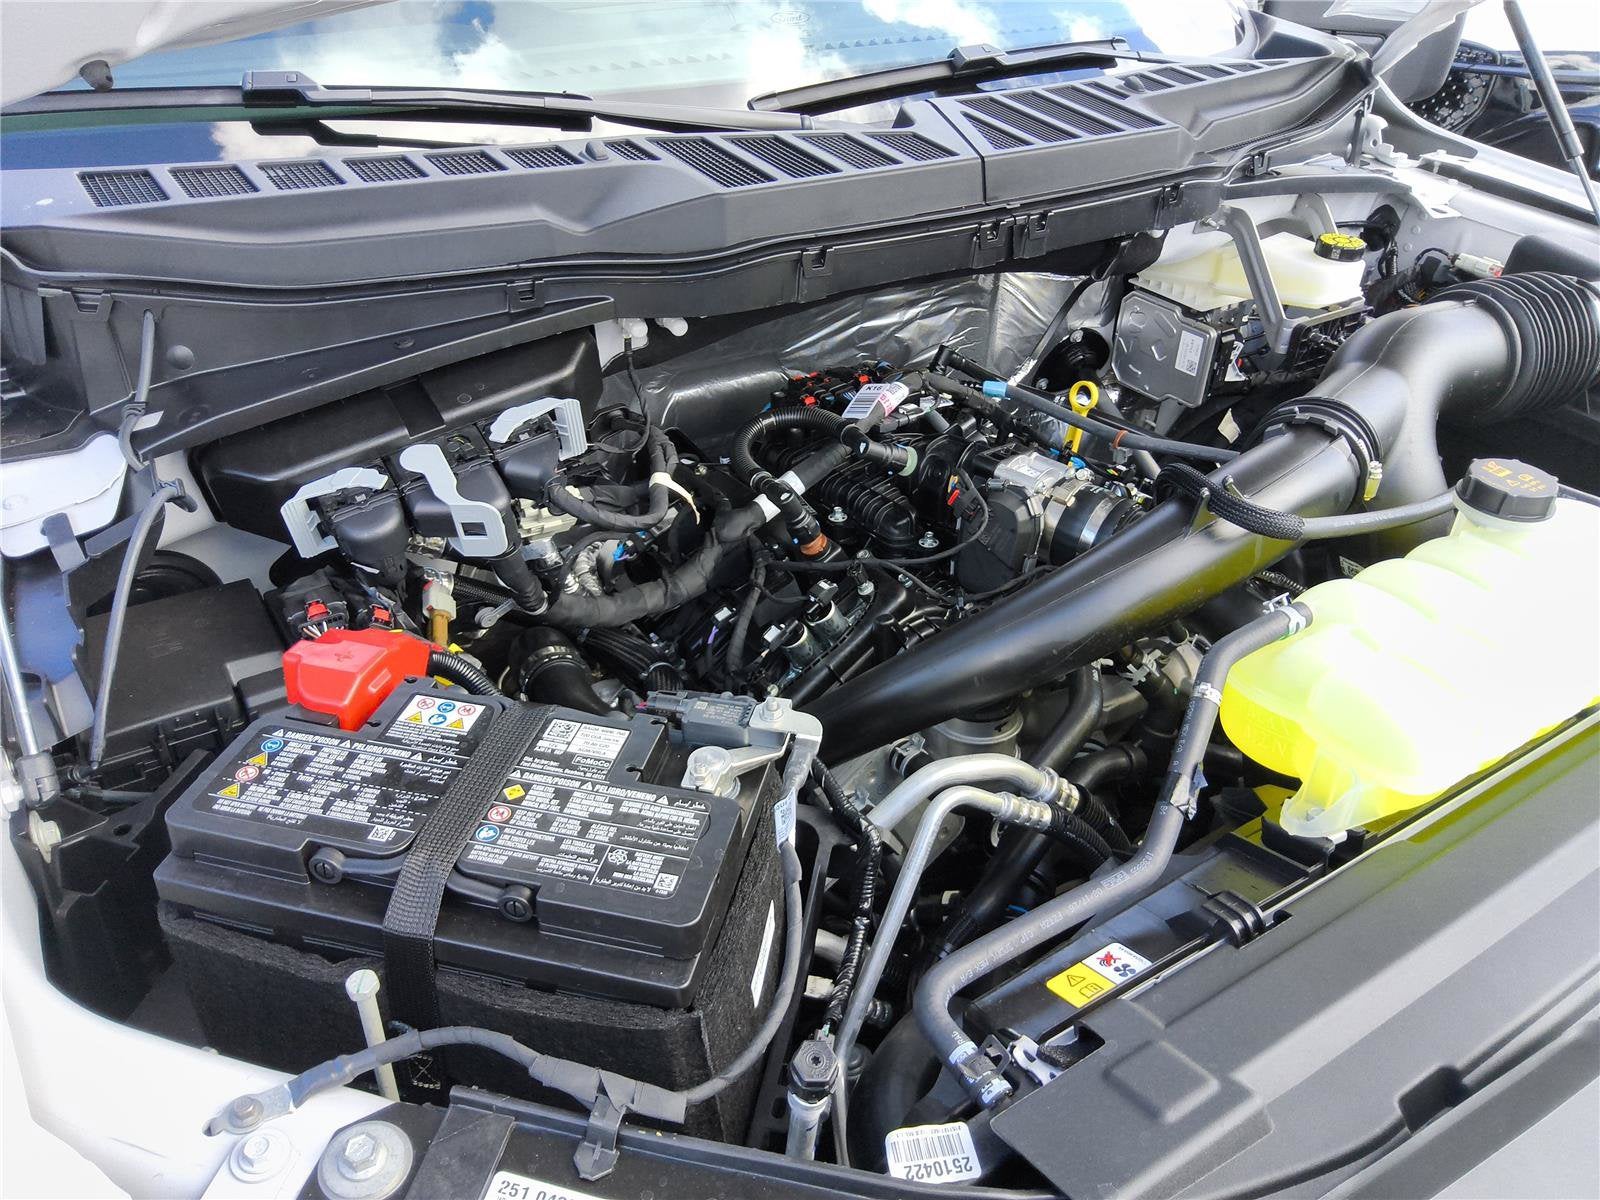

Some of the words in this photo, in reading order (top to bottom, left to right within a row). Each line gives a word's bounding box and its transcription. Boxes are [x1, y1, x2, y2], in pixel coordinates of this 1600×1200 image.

[282, 730, 341, 746] DANGER/POISON
[350, 742, 412, 758] PELIGRO/VENENO
[574, 756, 611, 767] FoMoCo
[520, 771, 582, 788] DANGER/POISON
[593, 784, 658, 801] PELIGRO/VENENO
[904, 1157, 973, 1180] 2510422
[498, 1180, 530, 1200] 251
